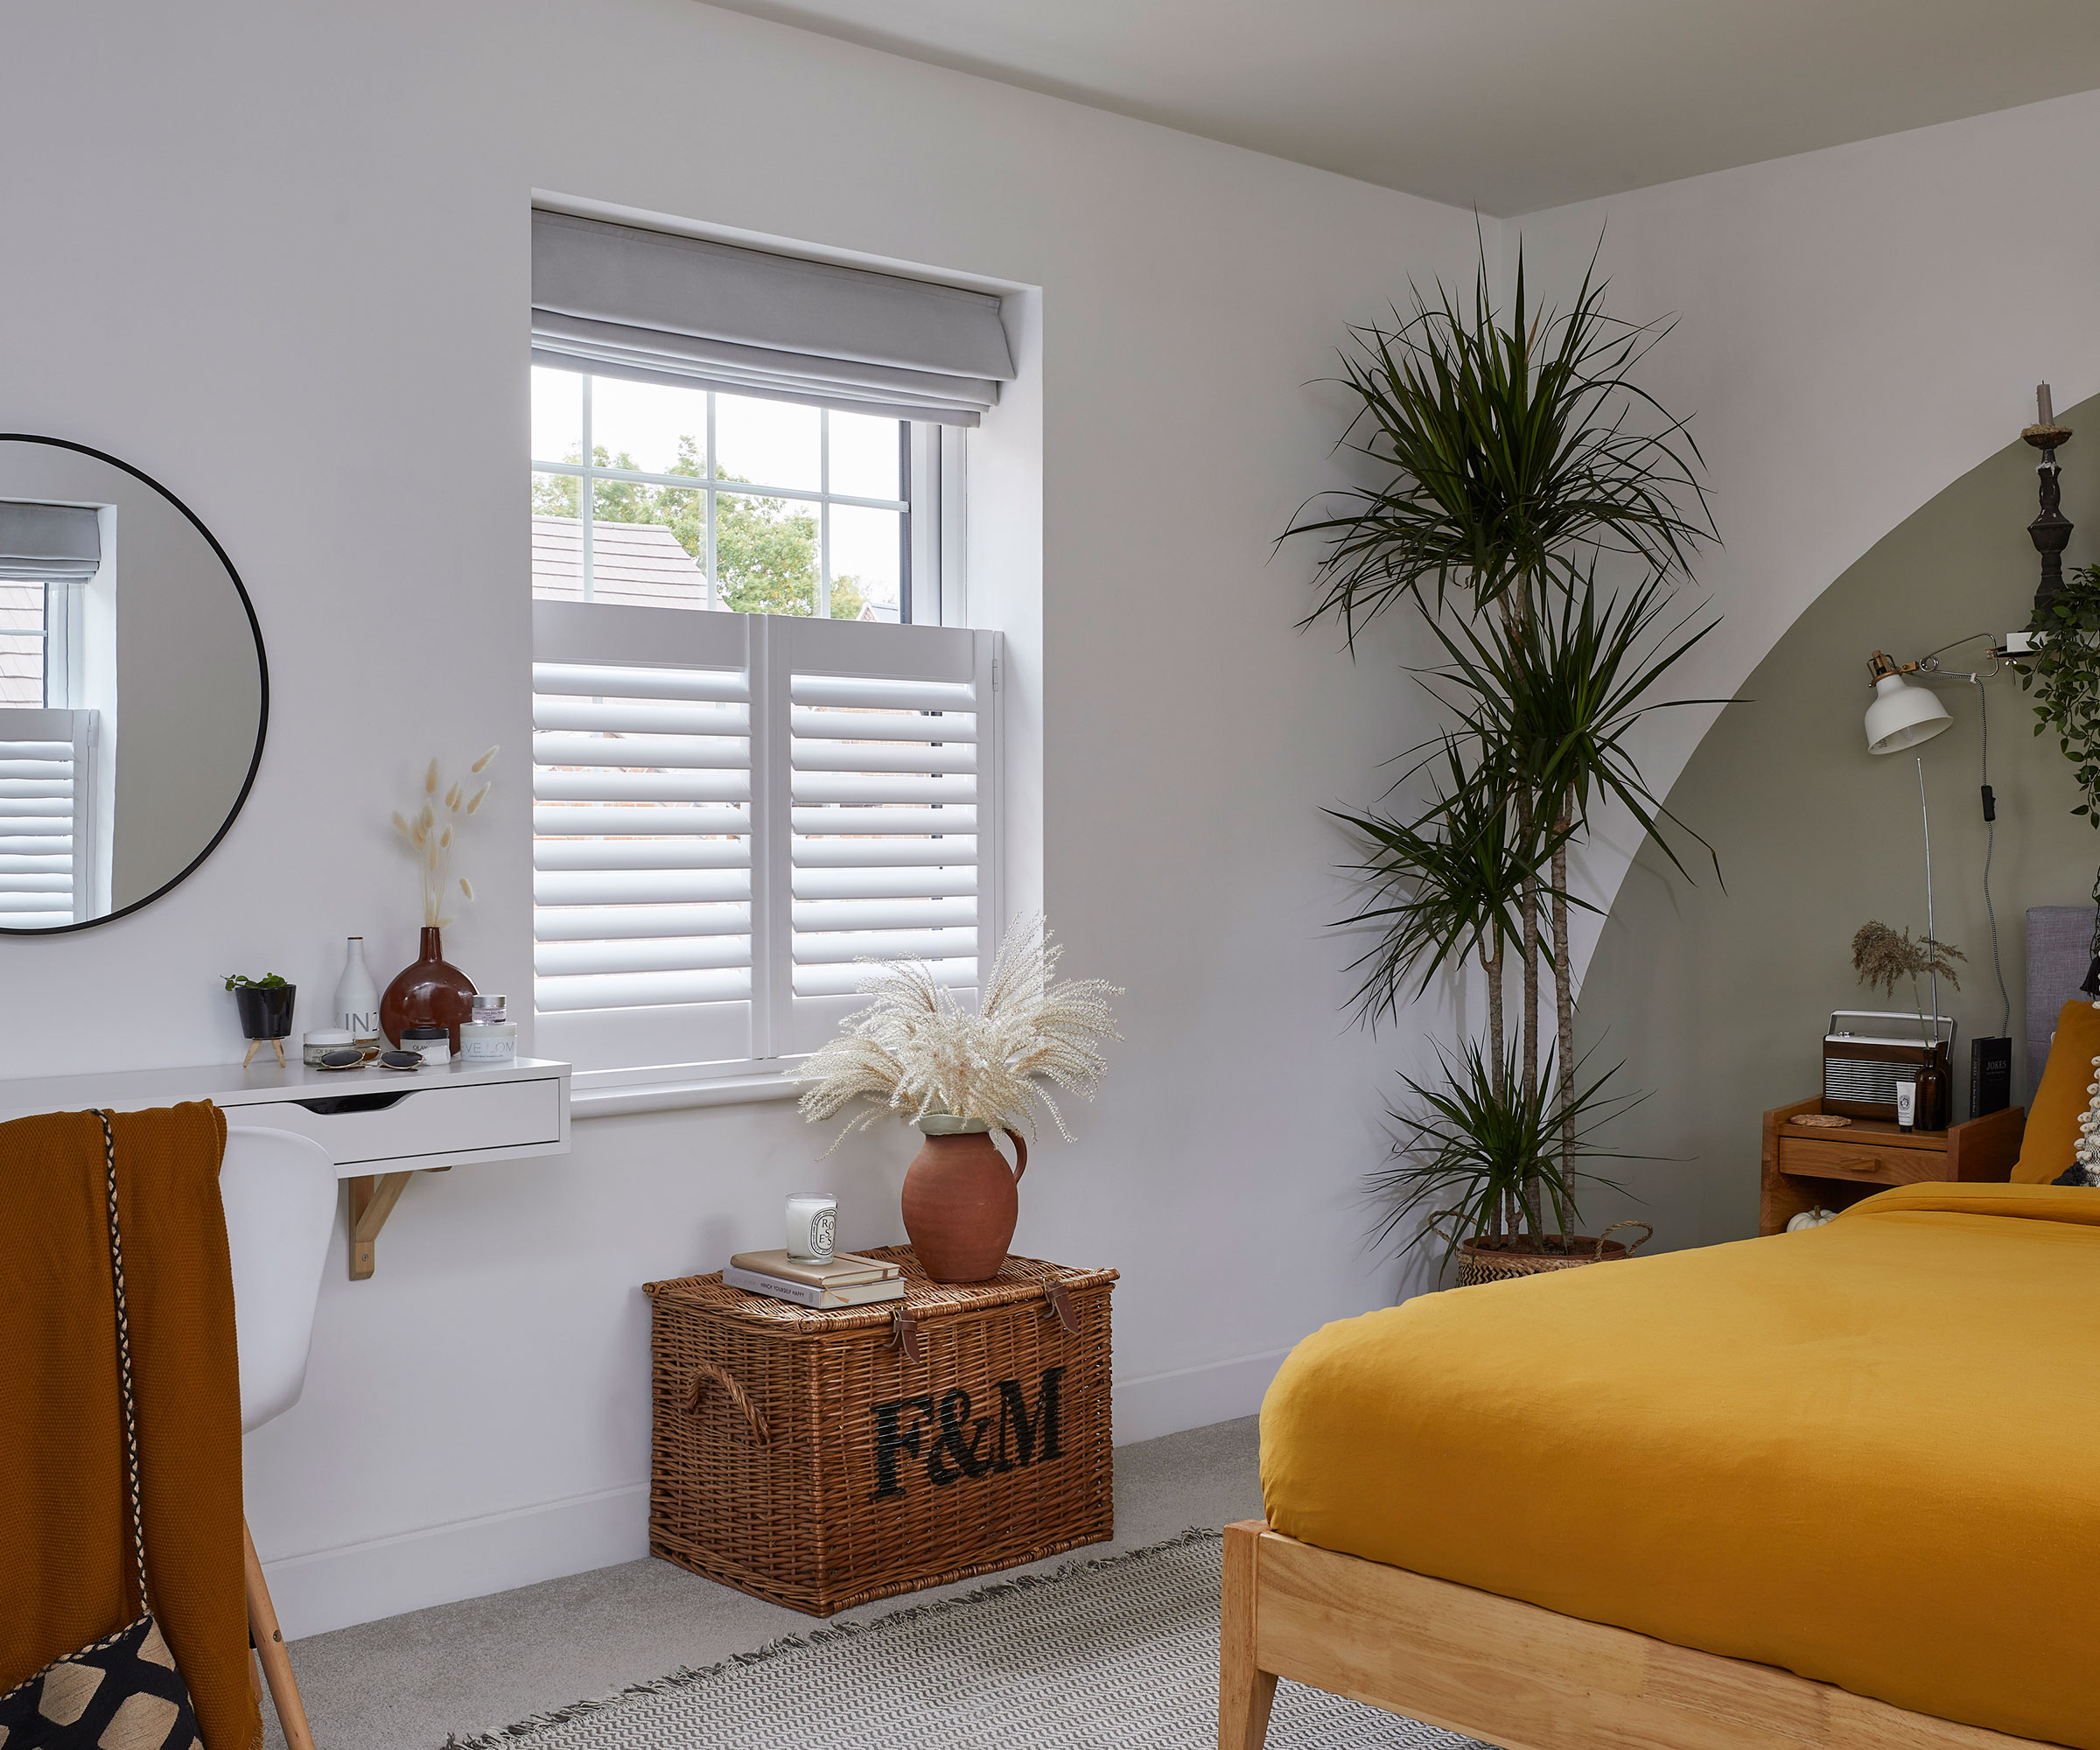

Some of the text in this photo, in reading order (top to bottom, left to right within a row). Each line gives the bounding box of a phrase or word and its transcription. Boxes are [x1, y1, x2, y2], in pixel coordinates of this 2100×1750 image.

[460, 1041, 514, 1054] EVE LOM
[1986, 1060, 2007, 1071] JOKES
[760, 1282, 774, 1291] HINCH
[774, 1284, 792, 1295] YOURSELF
[791, 1290, 805, 1298] HAPPY
[869, 1366, 1068, 1501] F&M
